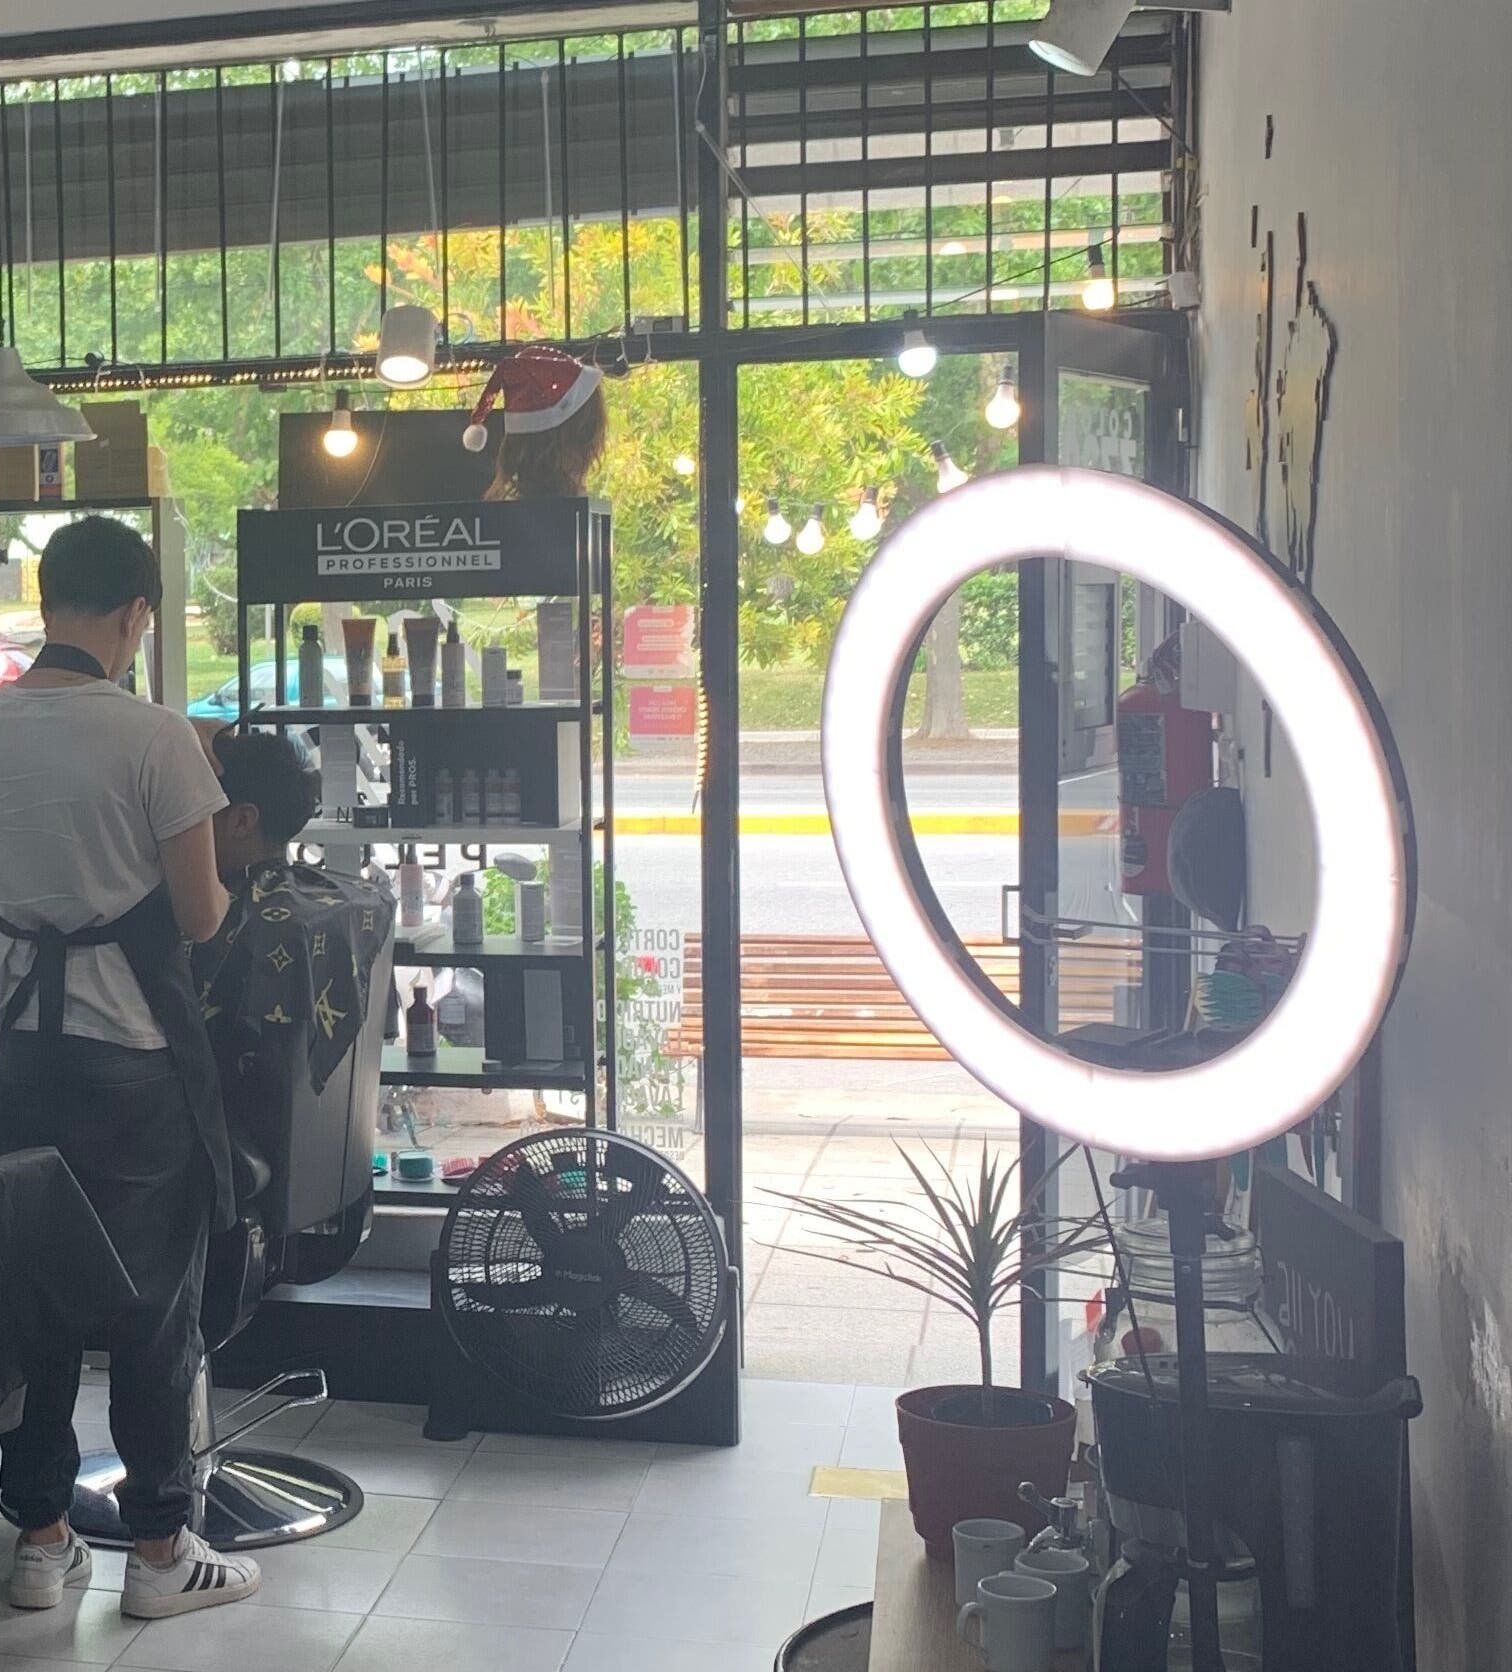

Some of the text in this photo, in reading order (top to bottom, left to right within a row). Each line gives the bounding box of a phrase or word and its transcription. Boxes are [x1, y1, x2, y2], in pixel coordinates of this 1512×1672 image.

[316, 514, 501, 553] L'ORÉAL
[325, 554, 494, 571] PROFESSIONNEL
[383, 576, 433, 589] PARIS
